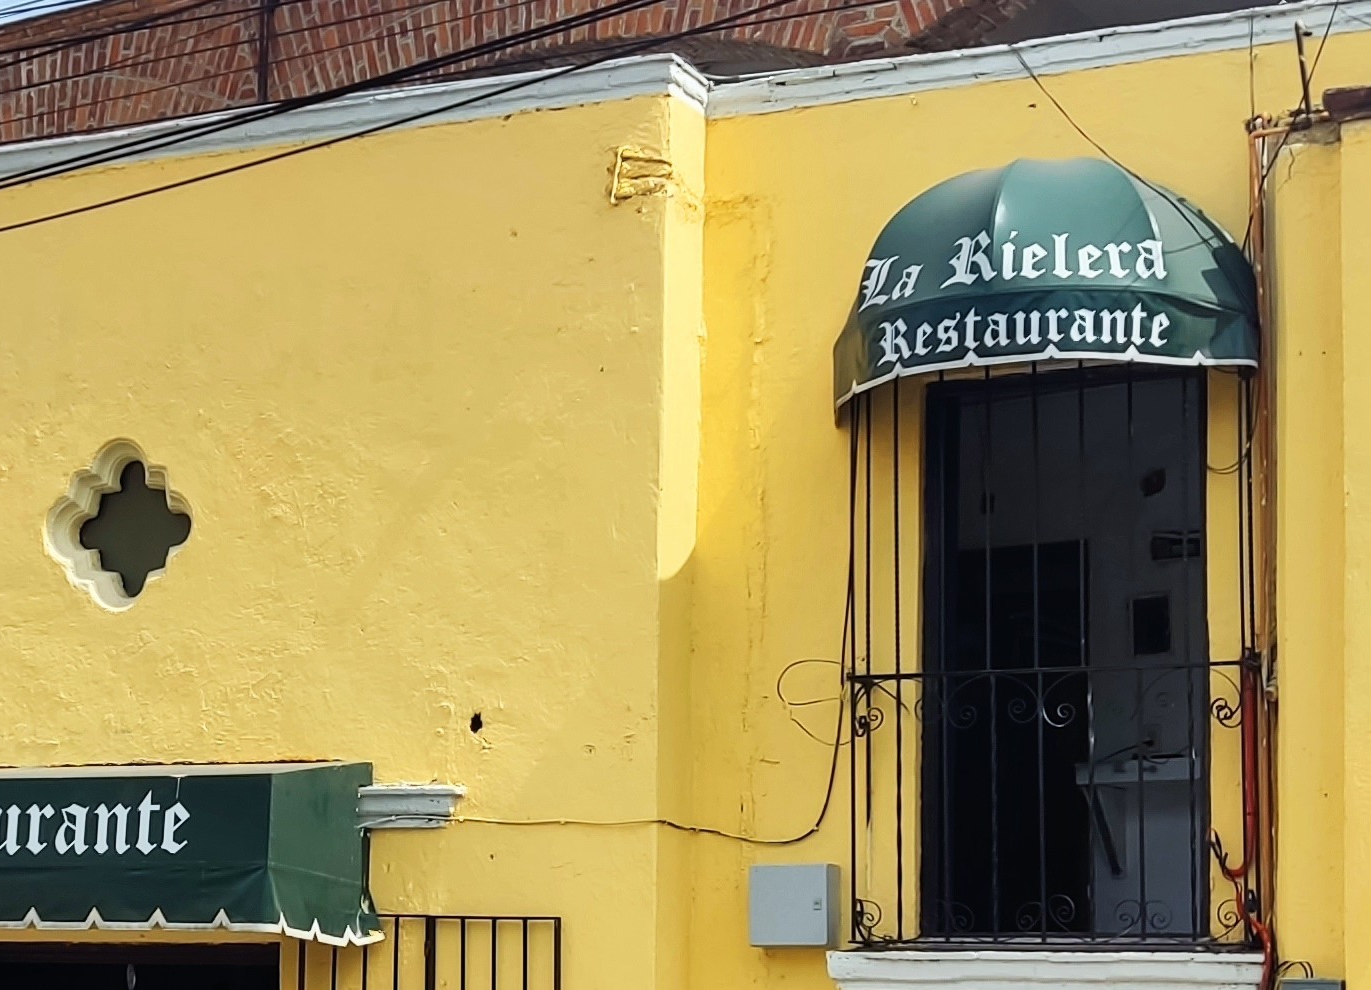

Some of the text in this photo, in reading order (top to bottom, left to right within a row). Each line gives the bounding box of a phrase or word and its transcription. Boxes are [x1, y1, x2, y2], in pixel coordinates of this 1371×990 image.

[859, 230, 1168, 314] La Rielera
[877, 302, 1171, 367] Restaurante
